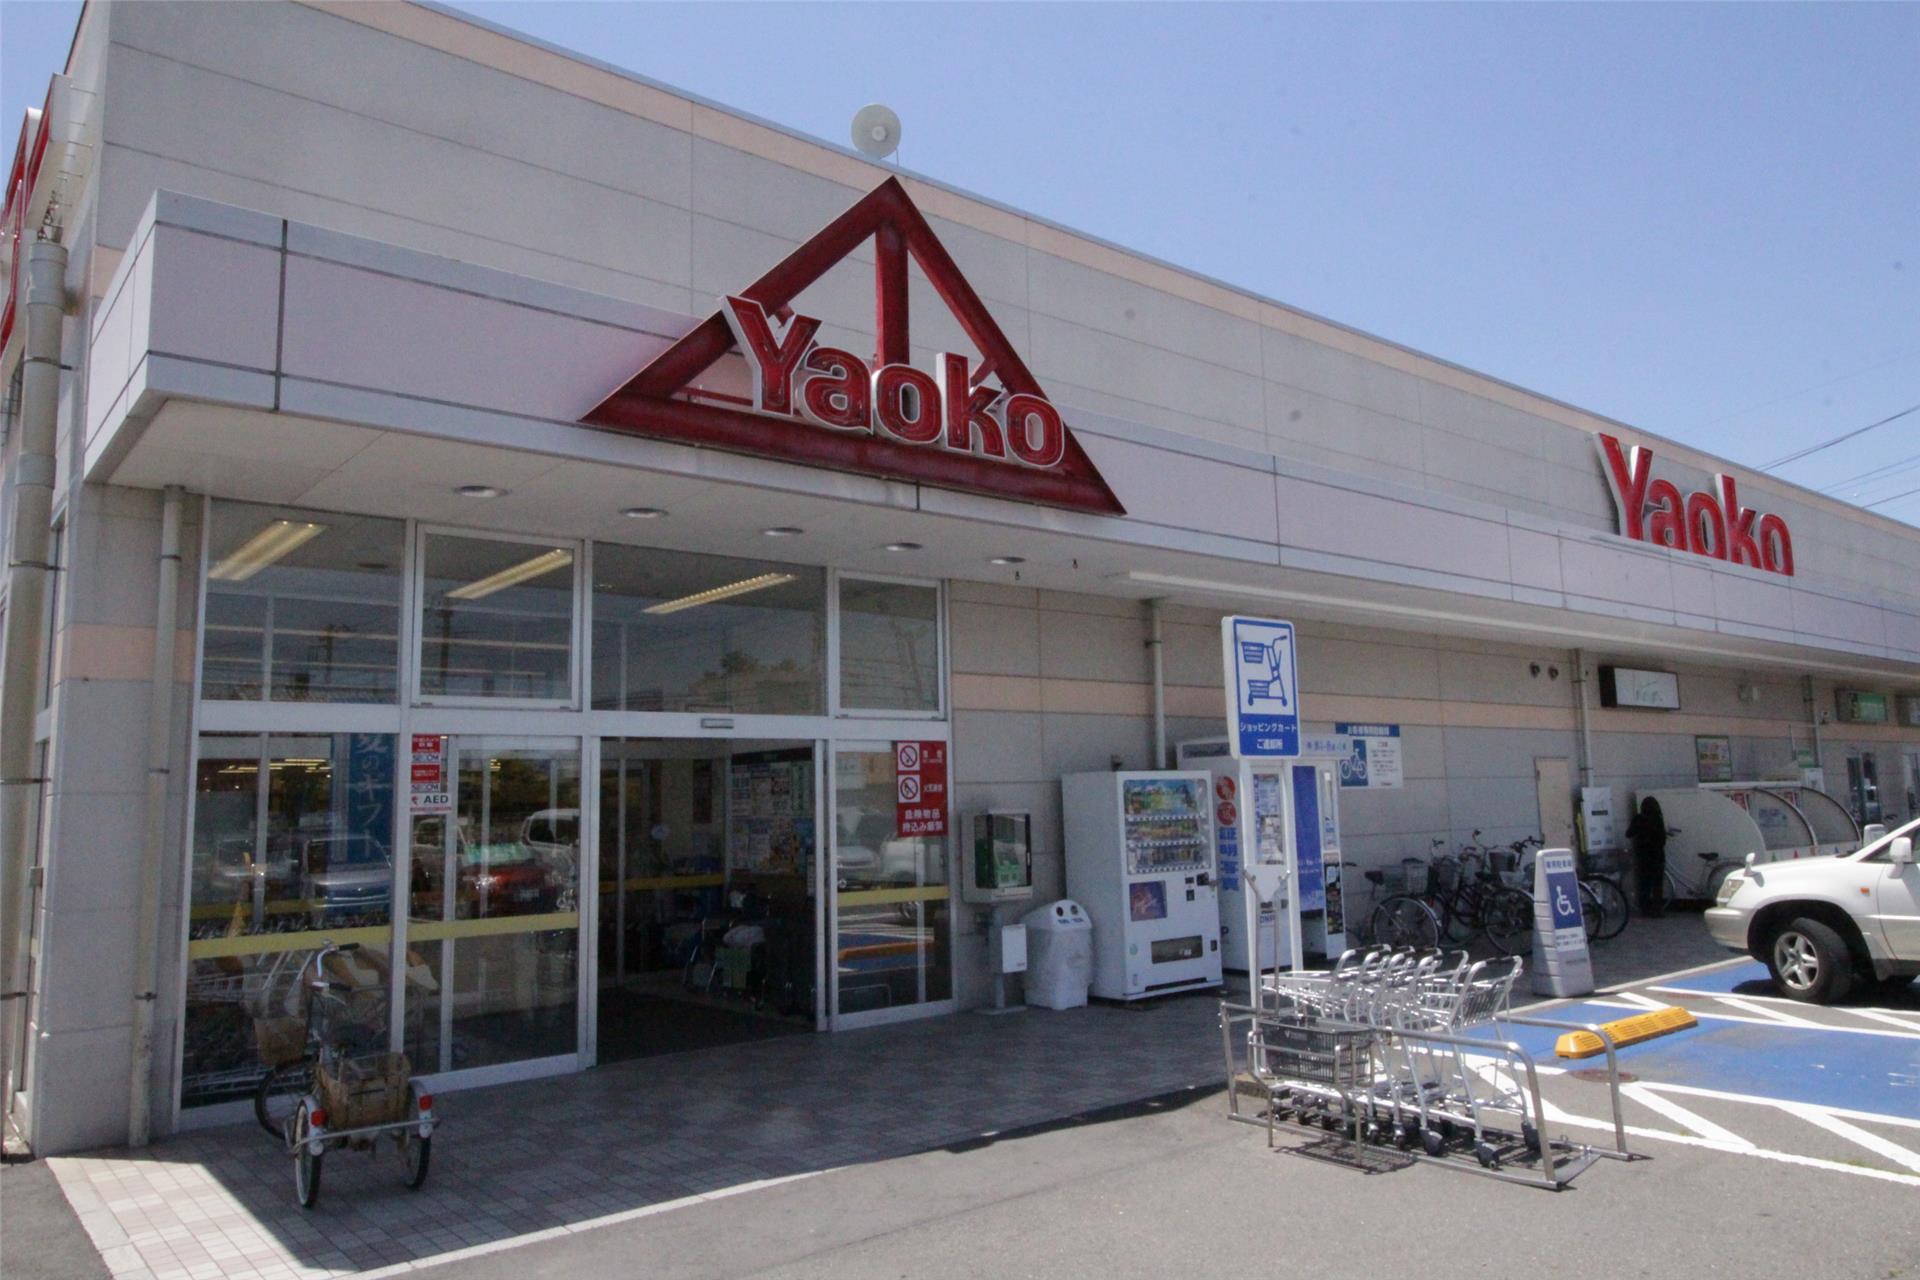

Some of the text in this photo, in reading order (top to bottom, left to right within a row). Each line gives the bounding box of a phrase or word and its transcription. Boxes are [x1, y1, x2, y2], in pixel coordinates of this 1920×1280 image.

[722, 296, 1065, 468] Yaoko
[1593, 432, 1794, 576] Yaoko
[1240, 722, 1297, 733] ショッピングカート
[424, 795, 449, 804] AED
